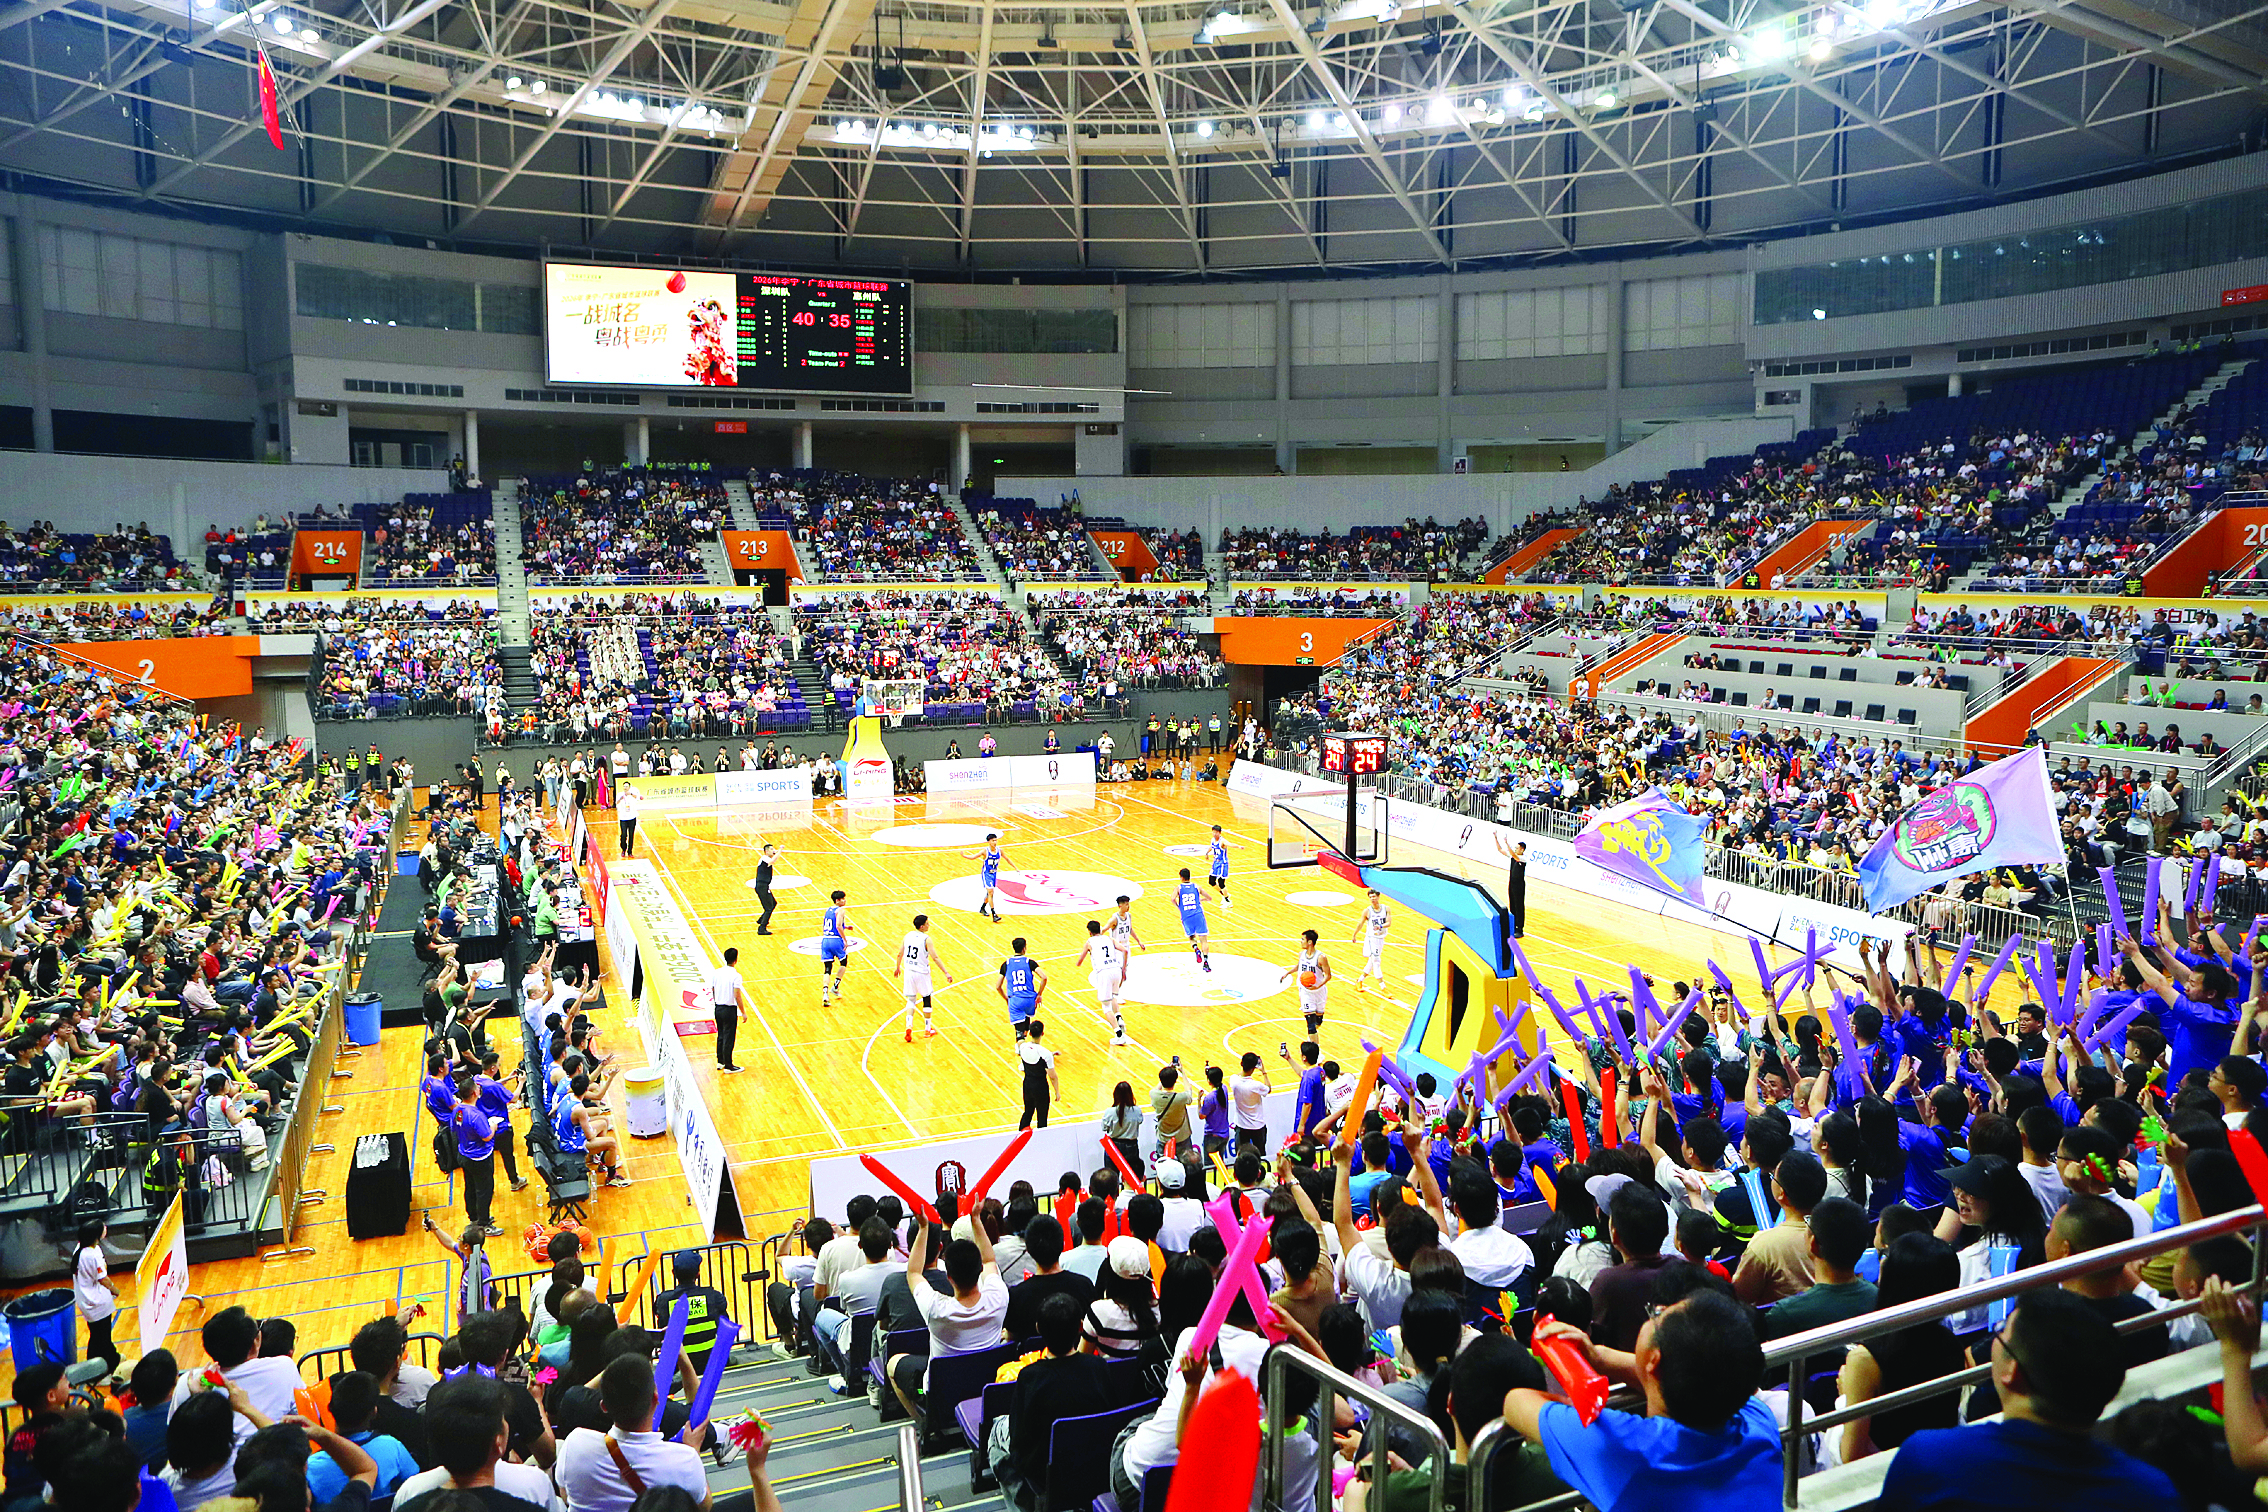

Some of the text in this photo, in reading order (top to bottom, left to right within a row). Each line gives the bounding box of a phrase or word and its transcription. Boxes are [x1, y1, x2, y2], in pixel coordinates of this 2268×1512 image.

[792, 311, 816, 327] 40
[828, 313, 852, 328] 35
[313, 541, 347, 557] 214
[740, 540, 768, 554] 213
[1101, 540, 1125, 553] 212
[1300, 631, 1313, 653] 3
[138, 658, 156, 684] 2
[1325, 751, 1343, 771] 24
[1354, 753, 1377, 773] 24
[853, 768, 887, 776] LI-NING
[757, 780, 800, 792] SPORTS
[1529, 850, 1570, 870] SPORTS
[1181, 893, 1196, 906] 22
[579, 907, 592, 927] 2
[906, 945, 919, 960] 13
[1011, 969, 1026, 986] 18
